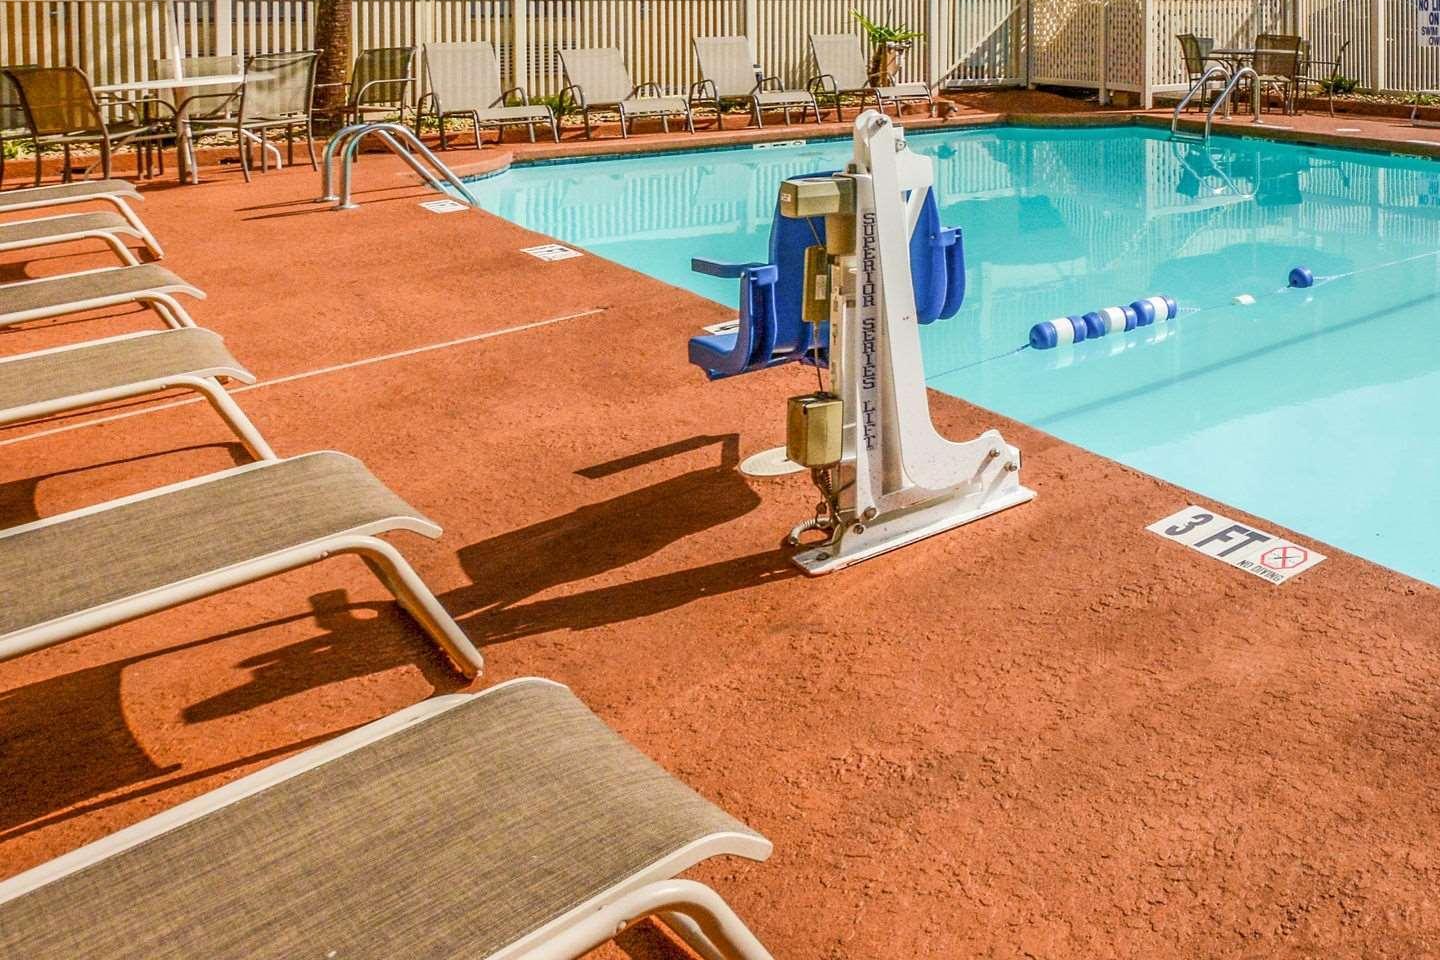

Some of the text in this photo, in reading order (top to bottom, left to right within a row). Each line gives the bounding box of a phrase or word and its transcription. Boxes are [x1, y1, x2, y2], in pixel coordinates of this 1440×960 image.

[1428, 12, 1440, 25] ON
[1421, 26, 1438, 36] SWIM
[862, 212, 876, 451] SUPERIOR SERIES LIFT
[1164, 513, 1271, 558] 3 FT
[1237, 559, 1284, 582] NO DIVING
